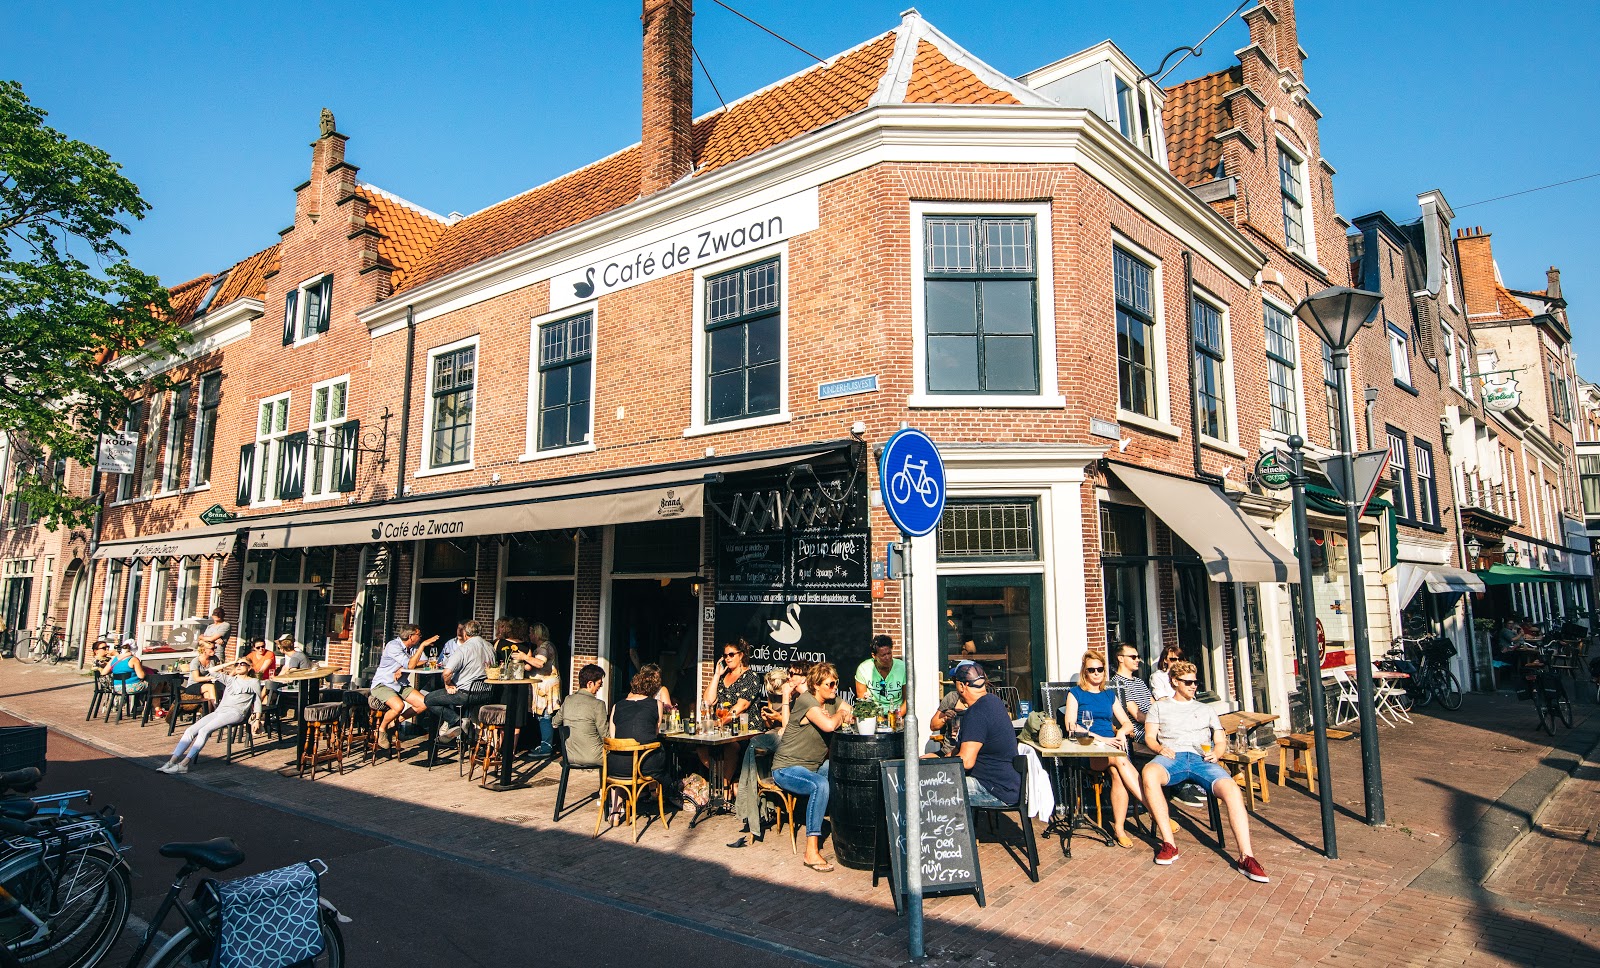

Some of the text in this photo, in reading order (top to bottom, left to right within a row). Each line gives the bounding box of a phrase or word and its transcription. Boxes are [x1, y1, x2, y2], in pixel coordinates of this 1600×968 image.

[602, 215, 783, 288] Café de Zwaan
[822, 378, 872, 395] KINDERHUISVEST
[105, 438, 133, 447] KOOP
[660, 497, 681, 508] Brand
[384, 519, 464, 539] Café de Zwaan
[705, 609, 715, 620] 53
[773, 647, 788, 661] de
[790, 647, 826, 663] Zwaan
[867, 680, 902, 688] NEER
[926, 810, 949, 823] thee
[939, 868, 970, 882] €7.50
